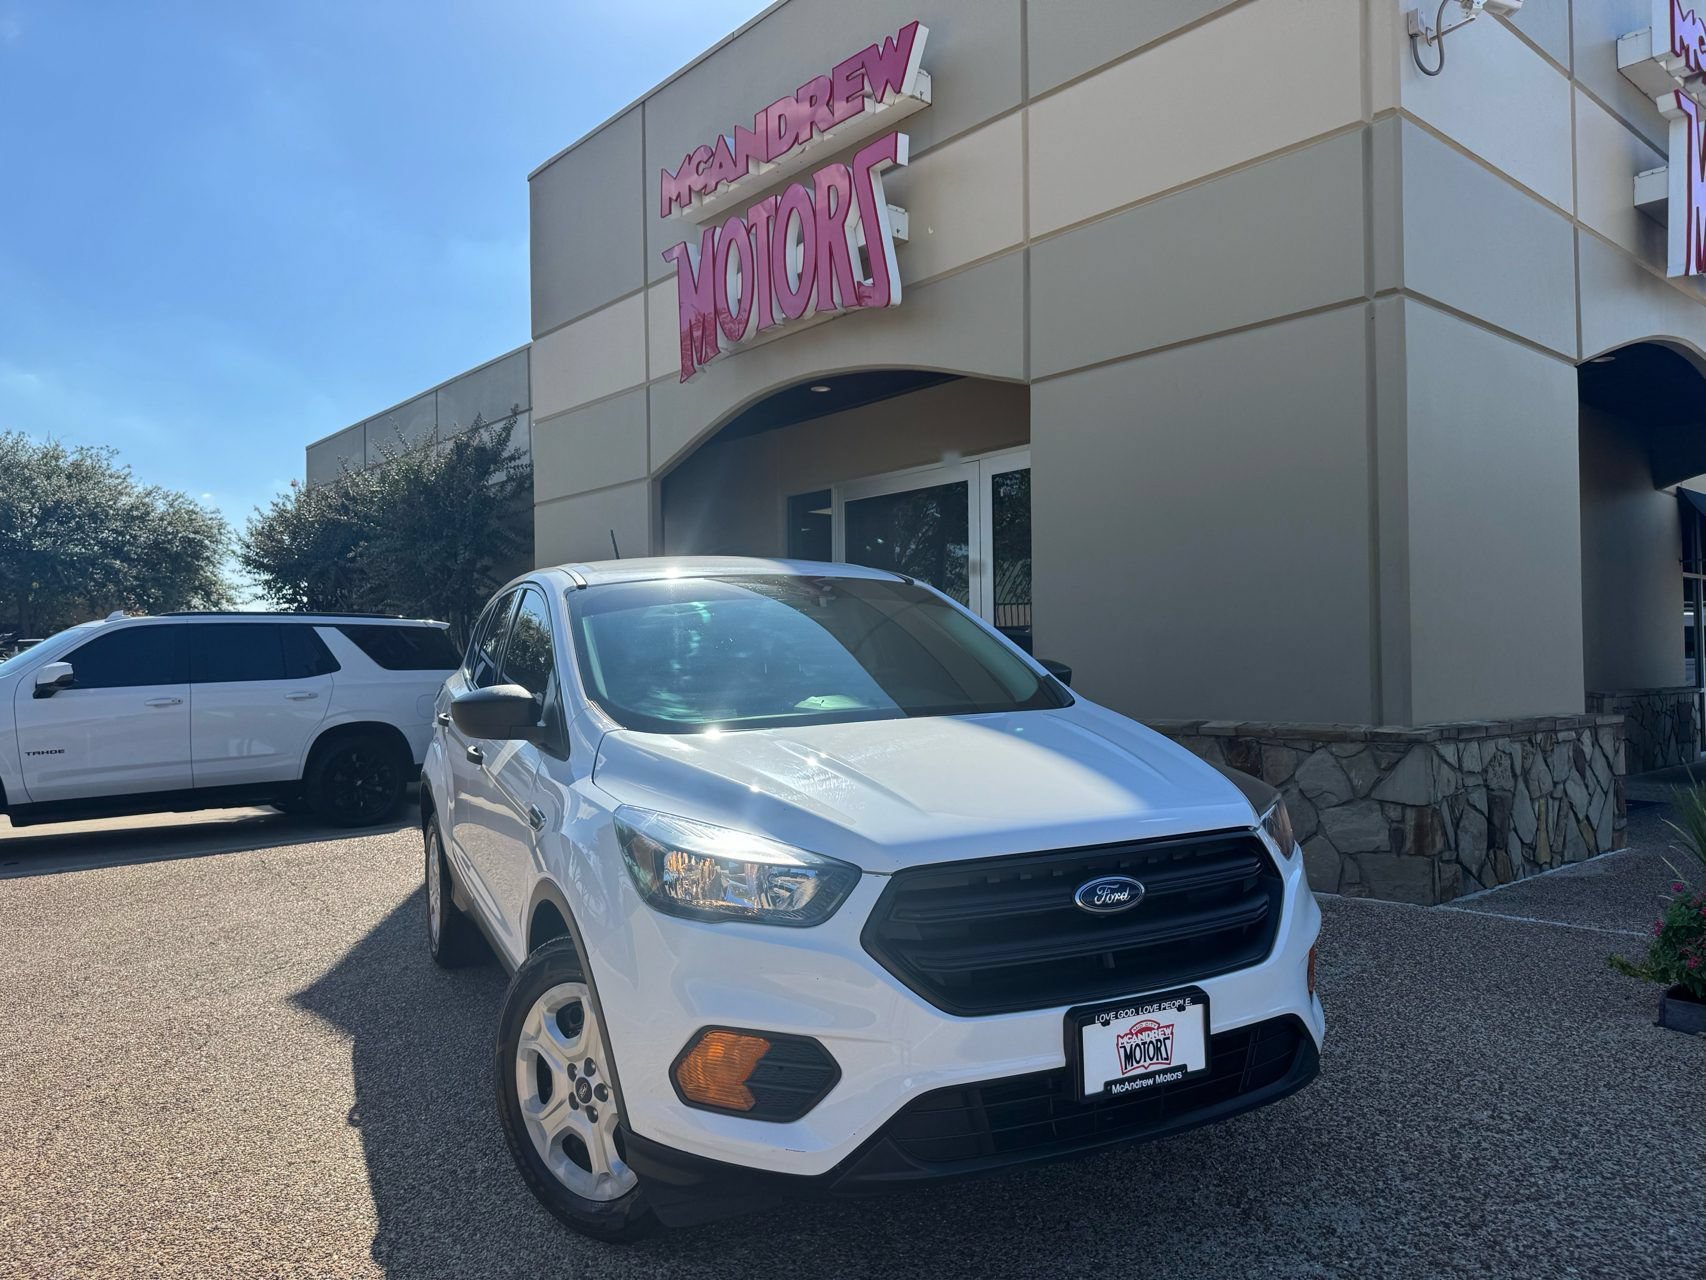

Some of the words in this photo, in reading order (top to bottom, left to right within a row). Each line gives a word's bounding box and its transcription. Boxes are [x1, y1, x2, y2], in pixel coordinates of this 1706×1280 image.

[662, 131, 900, 383] MOTORS
[25, 749, 65, 757] TAHOE
[1094, 883, 1131, 905] Ford
[1095, 1011, 1116, 1024] LOVE
[1117, 1008, 1137, 1019] GOD.
[1138, 1003, 1160, 1015] LOVE
[1119, 1036, 1171, 1071] MOTORS
[1111, 1078, 1154, 1095] McAndrew
[1155, 1071, 1182, 1085] Motors
